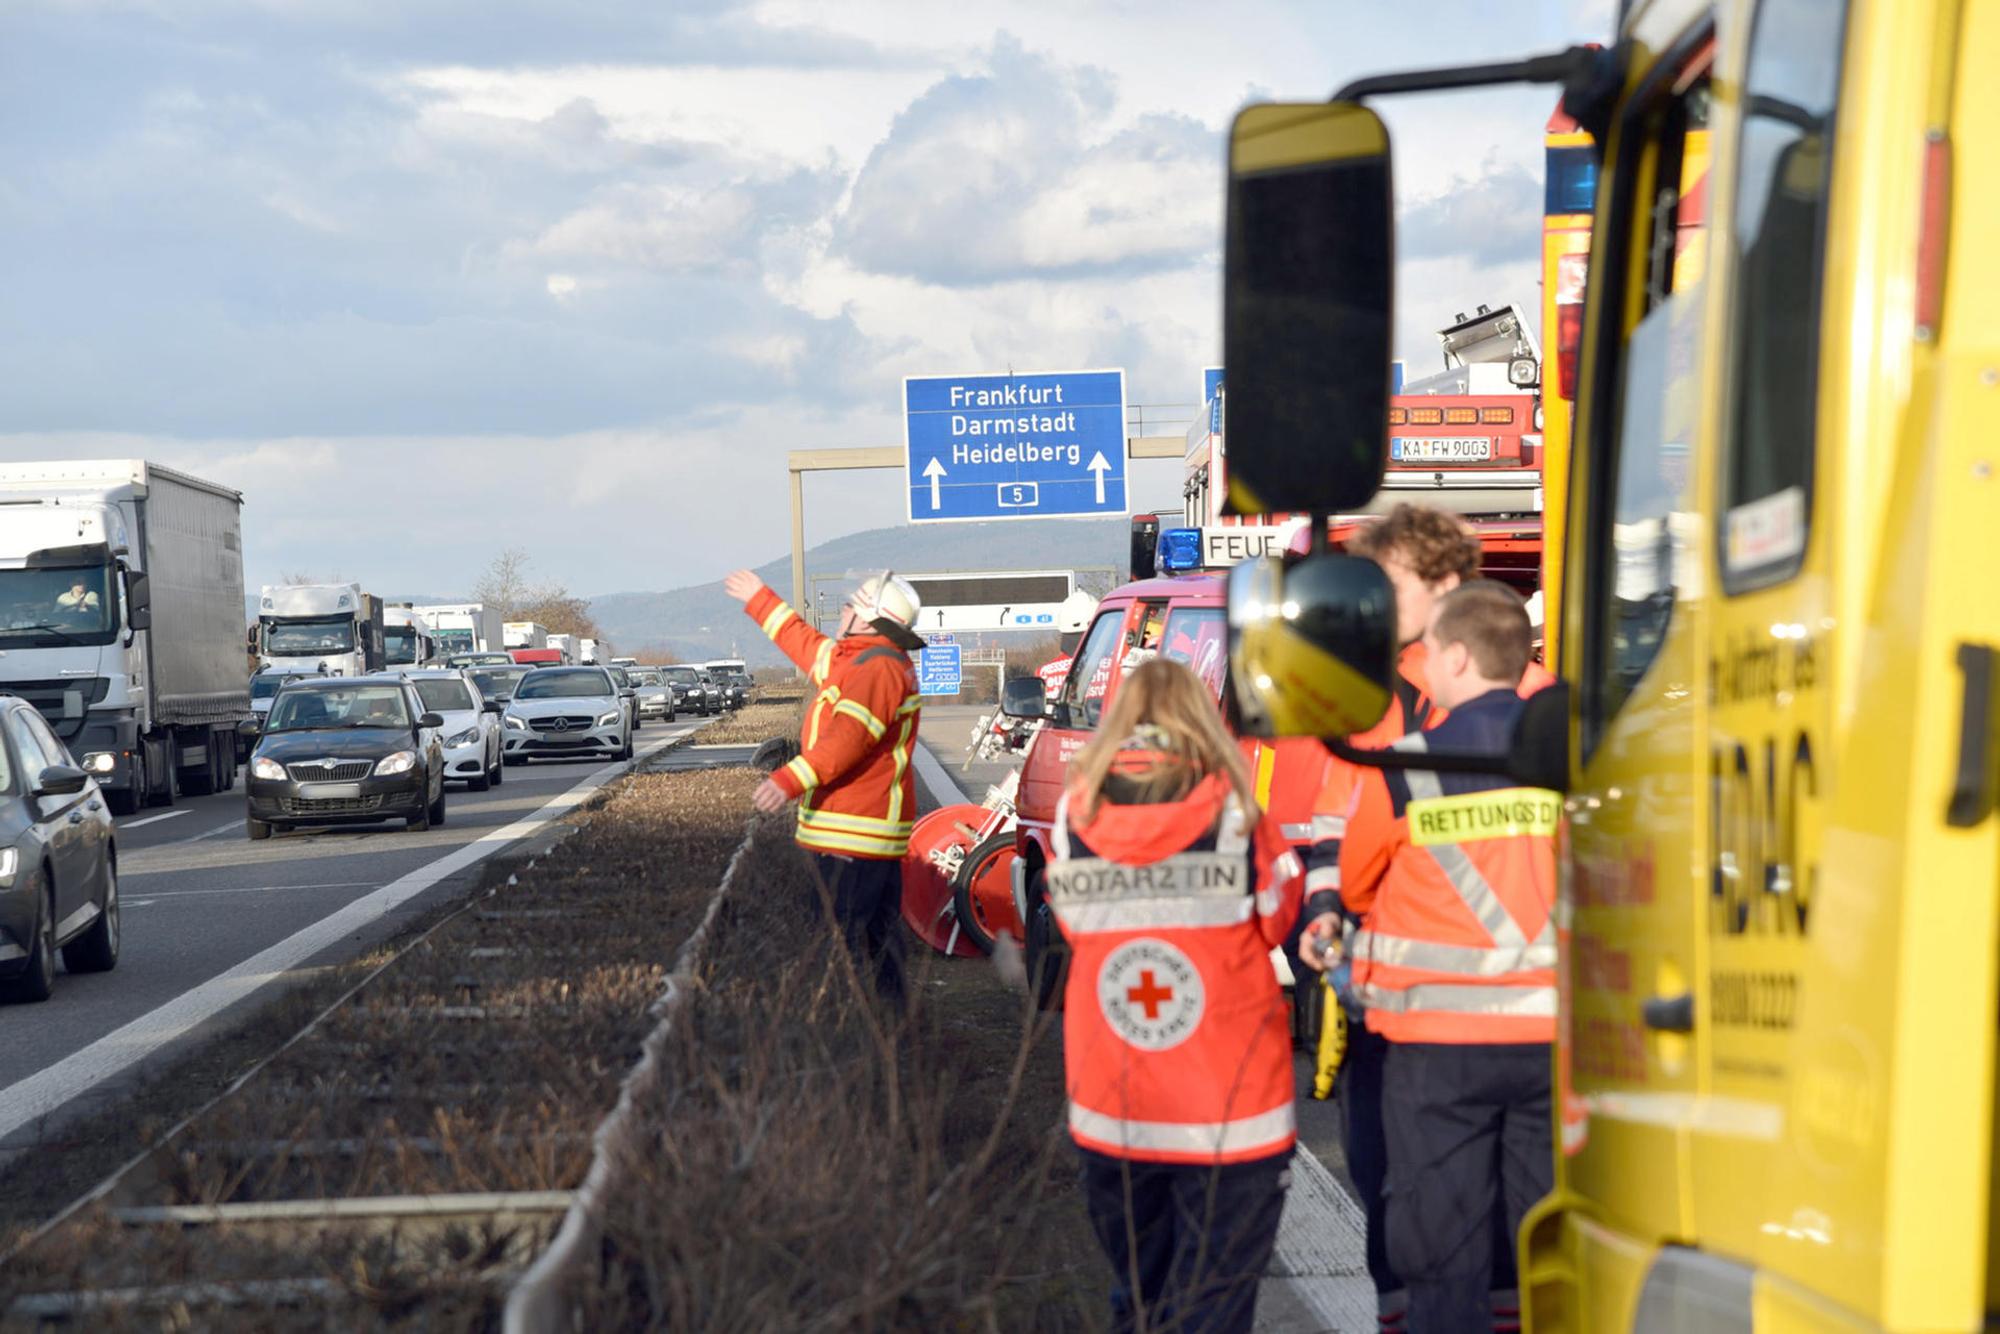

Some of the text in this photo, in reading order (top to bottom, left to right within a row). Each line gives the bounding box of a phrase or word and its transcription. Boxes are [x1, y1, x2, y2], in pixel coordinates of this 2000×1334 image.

[950, 384, 1063, 407] Frankfurt
[951, 412, 1076, 436] Darmstadt
[953, 442, 1081, 466] Heidelberg
[1403, 440, 1488, 456] KA FW 9003
[1013, 487, 1023, 502] 5
